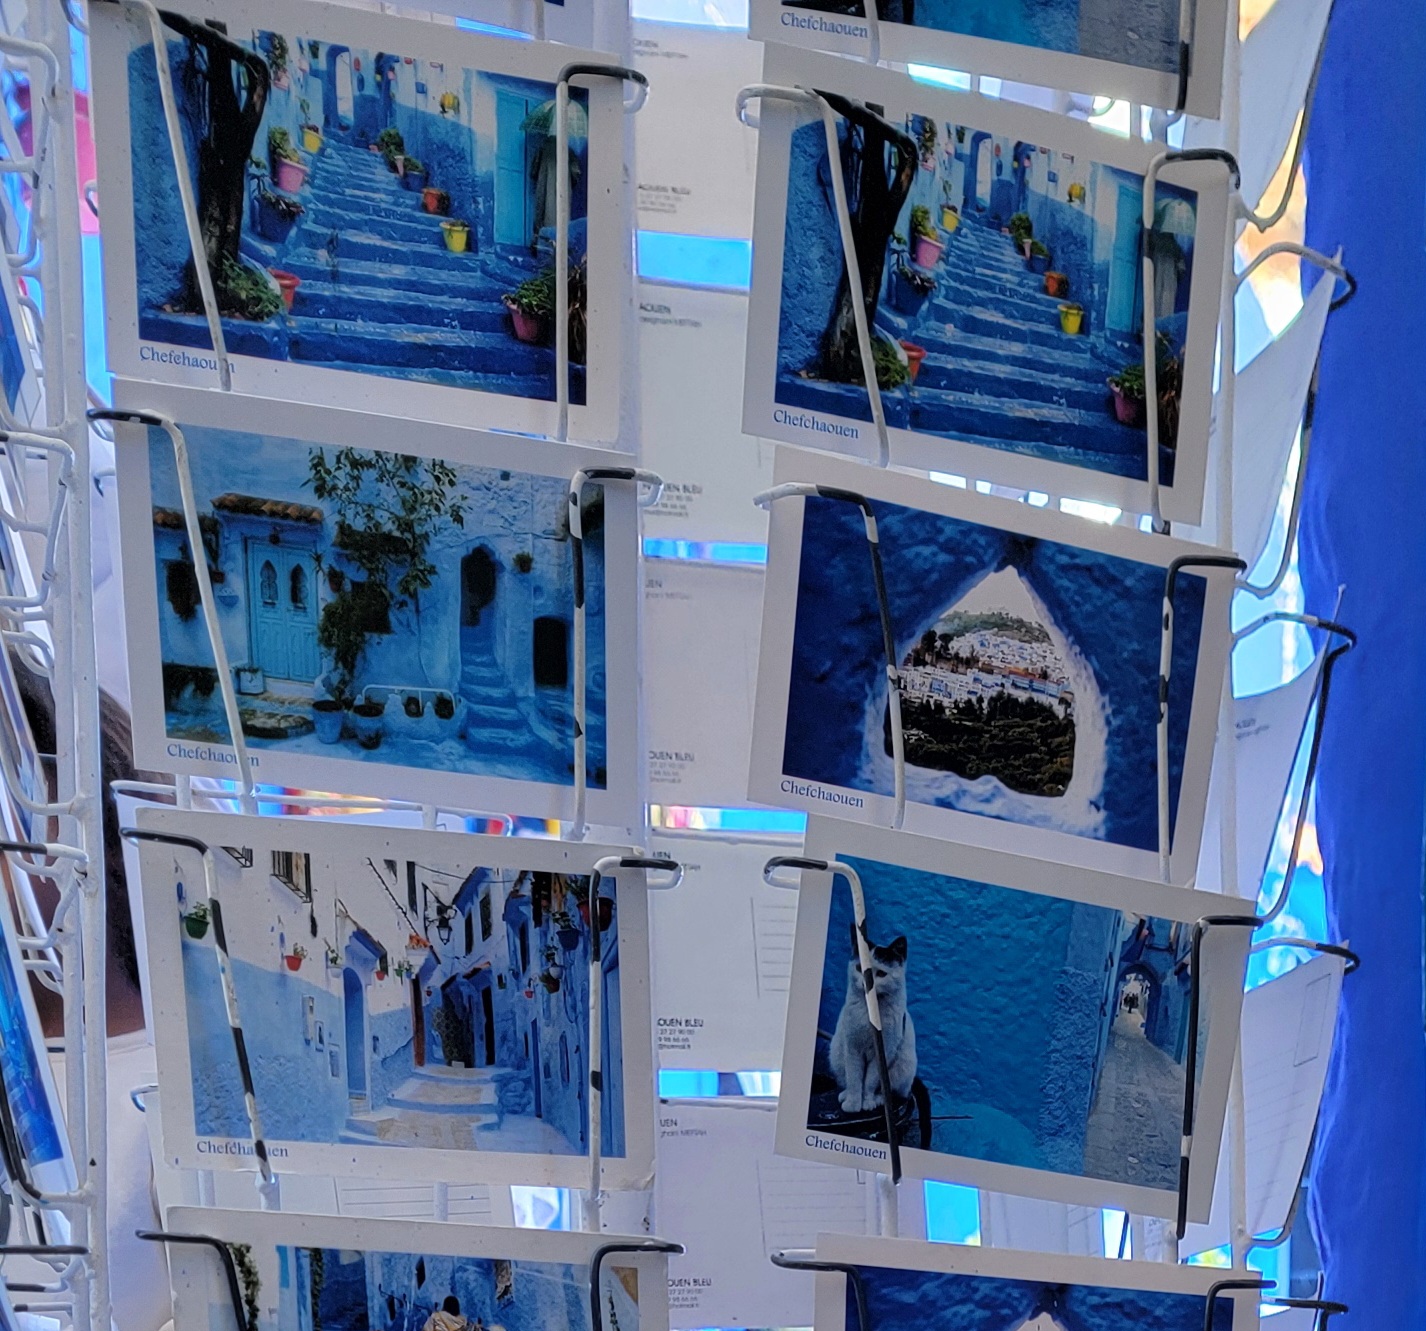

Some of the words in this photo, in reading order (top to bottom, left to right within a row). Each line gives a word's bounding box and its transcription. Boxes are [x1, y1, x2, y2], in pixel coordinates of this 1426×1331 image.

[780, 12, 868, 38] Chefchaouen
[140, 346, 235, 373] Chefchaoun
[773, 409, 859, 440] Chefchaouen
[167, 743, 259, 767] Chefchaon
[780, 780, 864, 808] Chefchaouen
[196, 1140, 288, 1158] Chefchaen
[805, 1135, 887, 1160] Chefchaouen
[693, 1278, 712, 1286] BLEU
